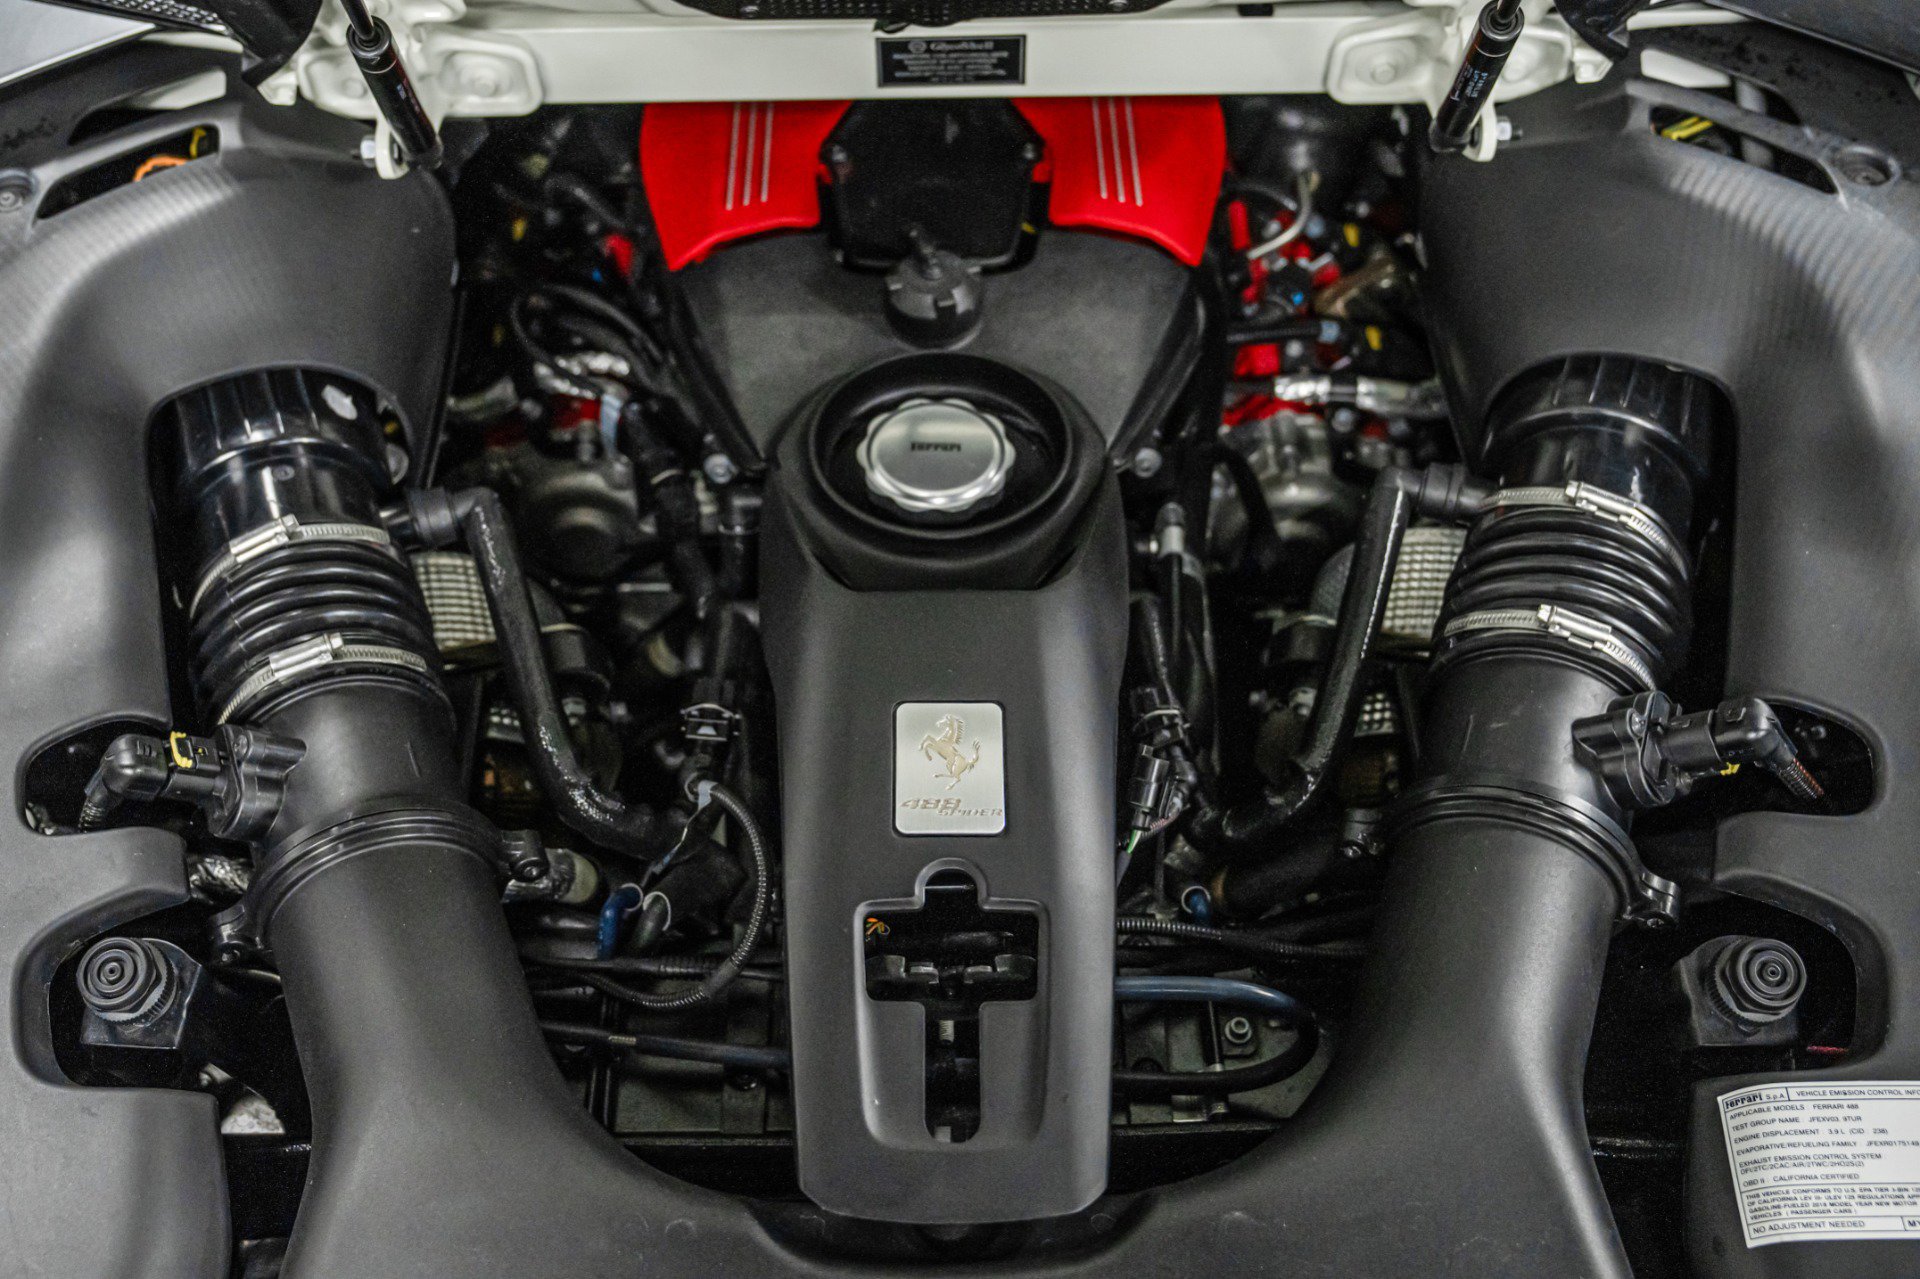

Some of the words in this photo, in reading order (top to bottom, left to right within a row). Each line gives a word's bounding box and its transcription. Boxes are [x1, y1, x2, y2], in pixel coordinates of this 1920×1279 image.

[900, 797, 961, 810] 488
[1725, 1092, 1763, 1110] Ferrari
[1730, 1106, 1772, 1120] APPLICABLE
[1732, 1123, 1748, 1132] TEST
[1750, 1118, 1776, 1128] GROUP
[1734, 1133, 1760, 1144] ENGINE
[1739, 1156, 1771, 1168] EXHAUST
[1774, 1153, 1811, 1161] EMISSION
[1743, 1178, 1759, 1188] OBD
[1773, 1174, 1818, 1182] CALIFORNIA
[1762, 1189, 1790, 1197] VEHICLE
[1758, 1196, 1797, 1205] CALIFORNIA
[1750, 1211, 1782, 1220] VEHICLES
[1753, 1226, 1766, 1234] NO
[1768, 1221, 1827, 1231] ADJUSTMENT
[1828, 1220, 1865, 1228] NEEDED
